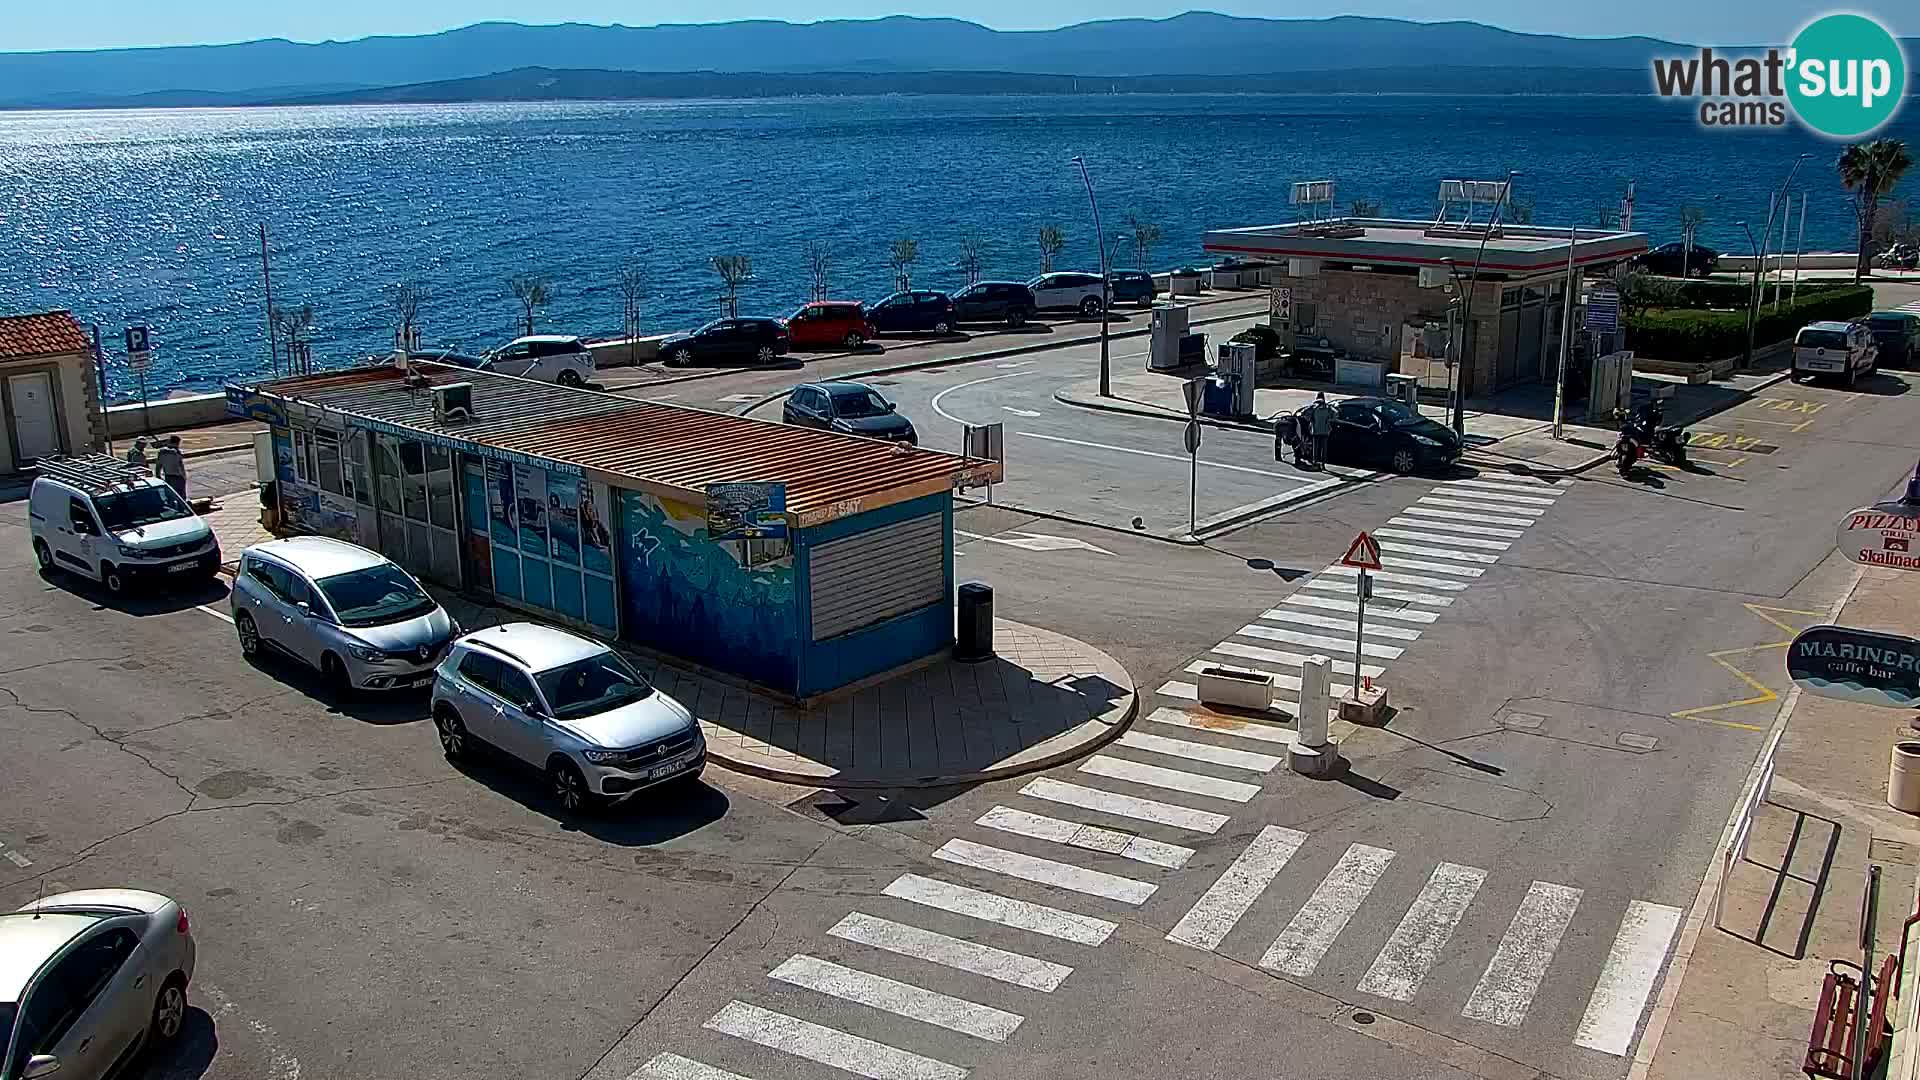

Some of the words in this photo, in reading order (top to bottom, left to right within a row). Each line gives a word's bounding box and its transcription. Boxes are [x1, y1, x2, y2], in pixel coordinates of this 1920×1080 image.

[131, 331, 143, 349] P
[1759, 400, 1828, 415] TAXI
[495, 449, 526, 464] STATION
[529, 456, 554, 471] TICKET
[556, 463, 582, 477] OFFICE
[1848, 515, 1920, 532] PIZZE
[1828, 661, 1864, 674] caffe
[1869, 665, 1896, 679] bar
